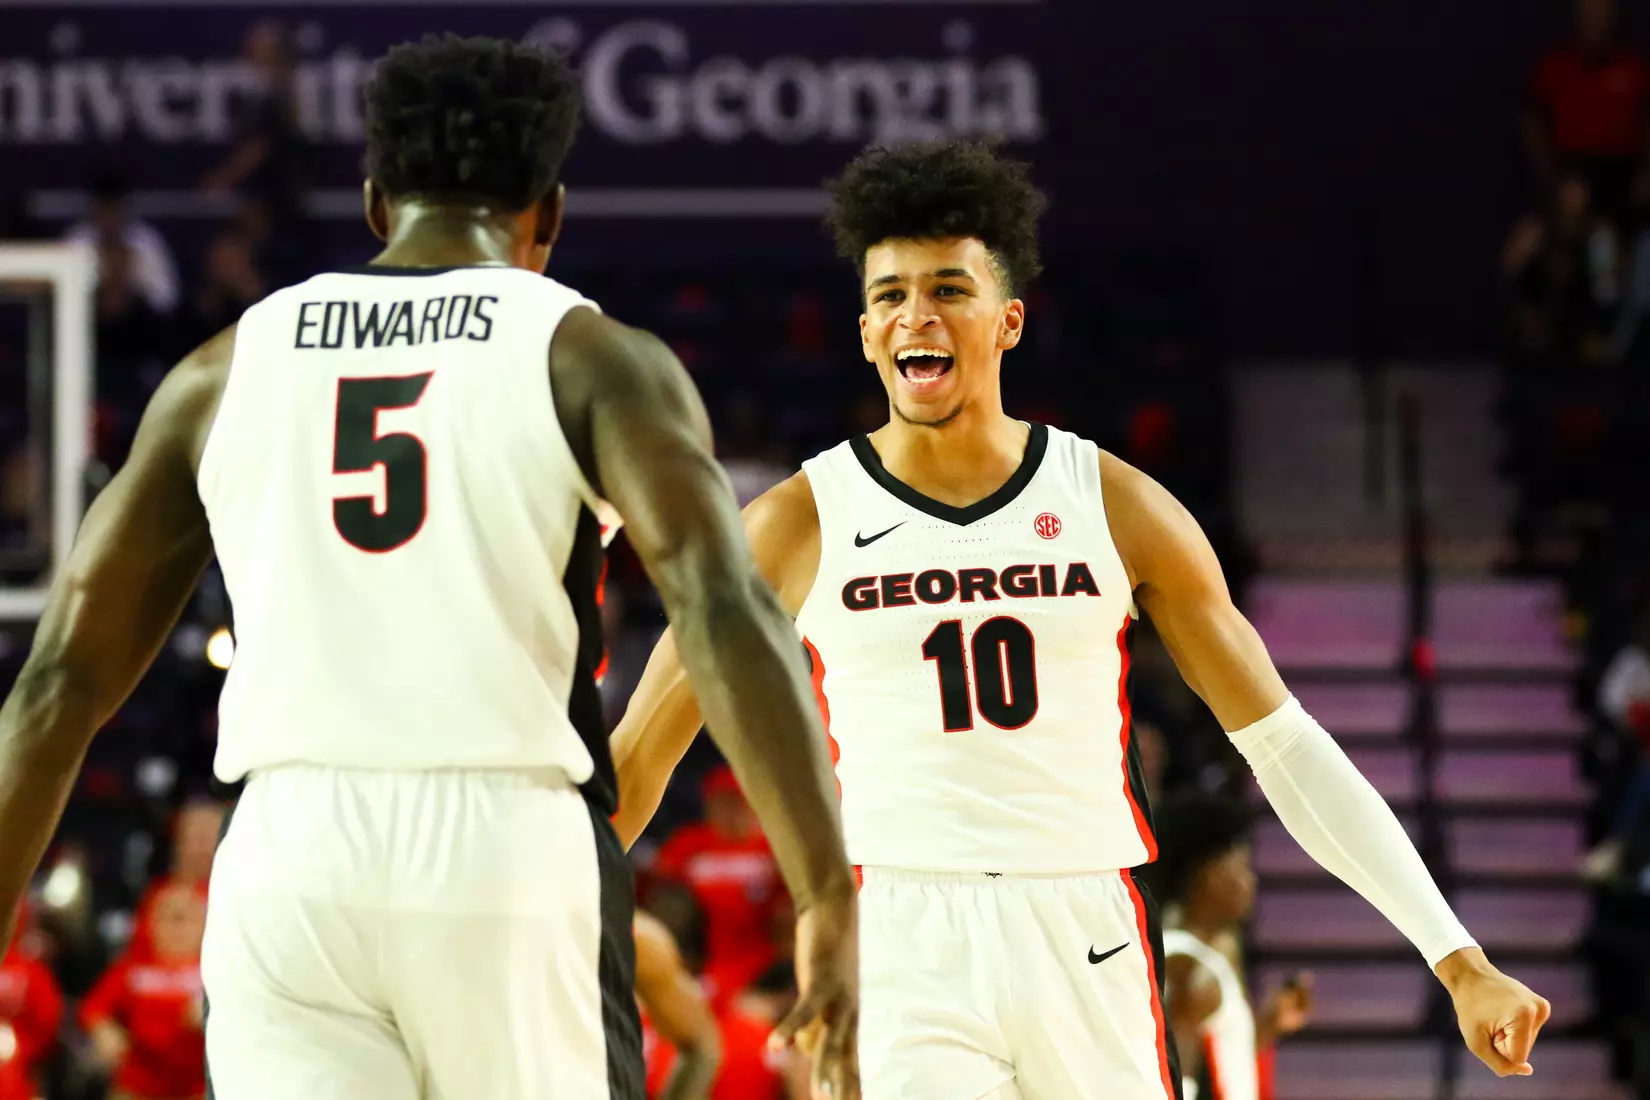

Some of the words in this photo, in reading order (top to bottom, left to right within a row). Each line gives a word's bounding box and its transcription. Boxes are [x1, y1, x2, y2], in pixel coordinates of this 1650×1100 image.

[0, 22, 374, 143] niverit
[582, 20, 1047, 146] Georgia
[294, 295, 499, 350] EDWARDS
[332, 370, 436, 554] 5
[1036, 514, 1060, 538] SEC
[841, 562, 1101, 612] GEORGIA
[921, 615, 1039, 733] 10
